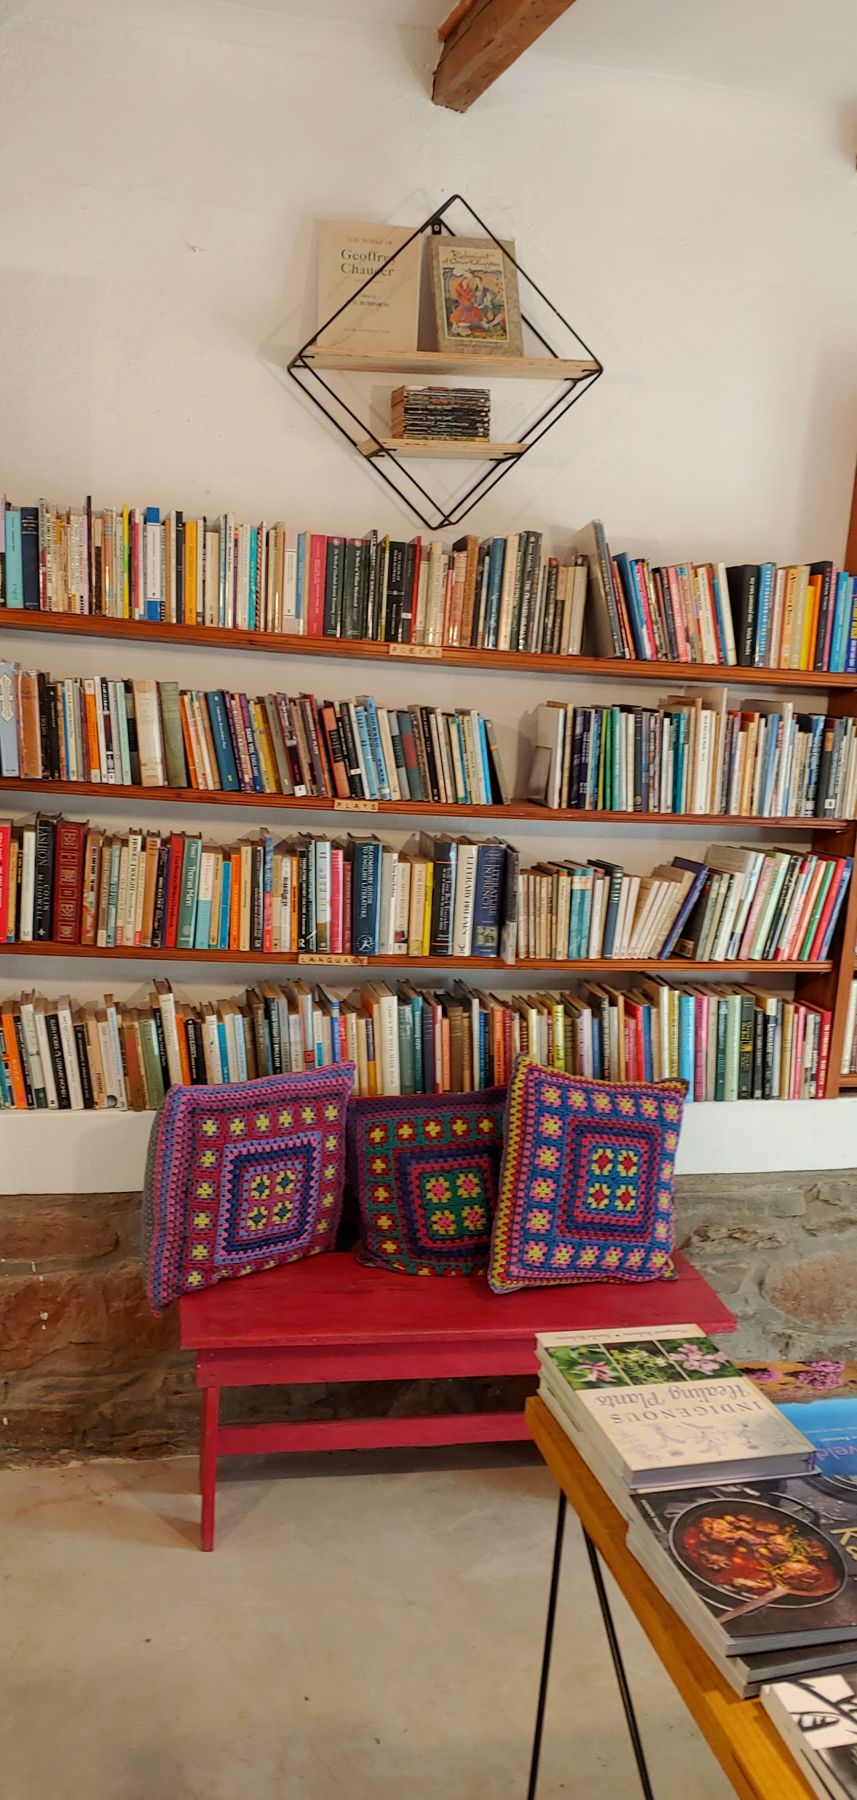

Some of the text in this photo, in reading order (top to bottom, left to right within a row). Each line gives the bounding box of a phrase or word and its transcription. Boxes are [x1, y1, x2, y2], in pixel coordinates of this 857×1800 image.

[340, 263, 395, 277] Chauer
[336, 801, 377, 811] PLAYS
[38, 825, 51, 866] FASHION
[186, 866, 196, 889] Thomas
[596, 1384, 750, 1409] Healing Plants
[610, 1400, 764, 1424] INDIGENOUS
